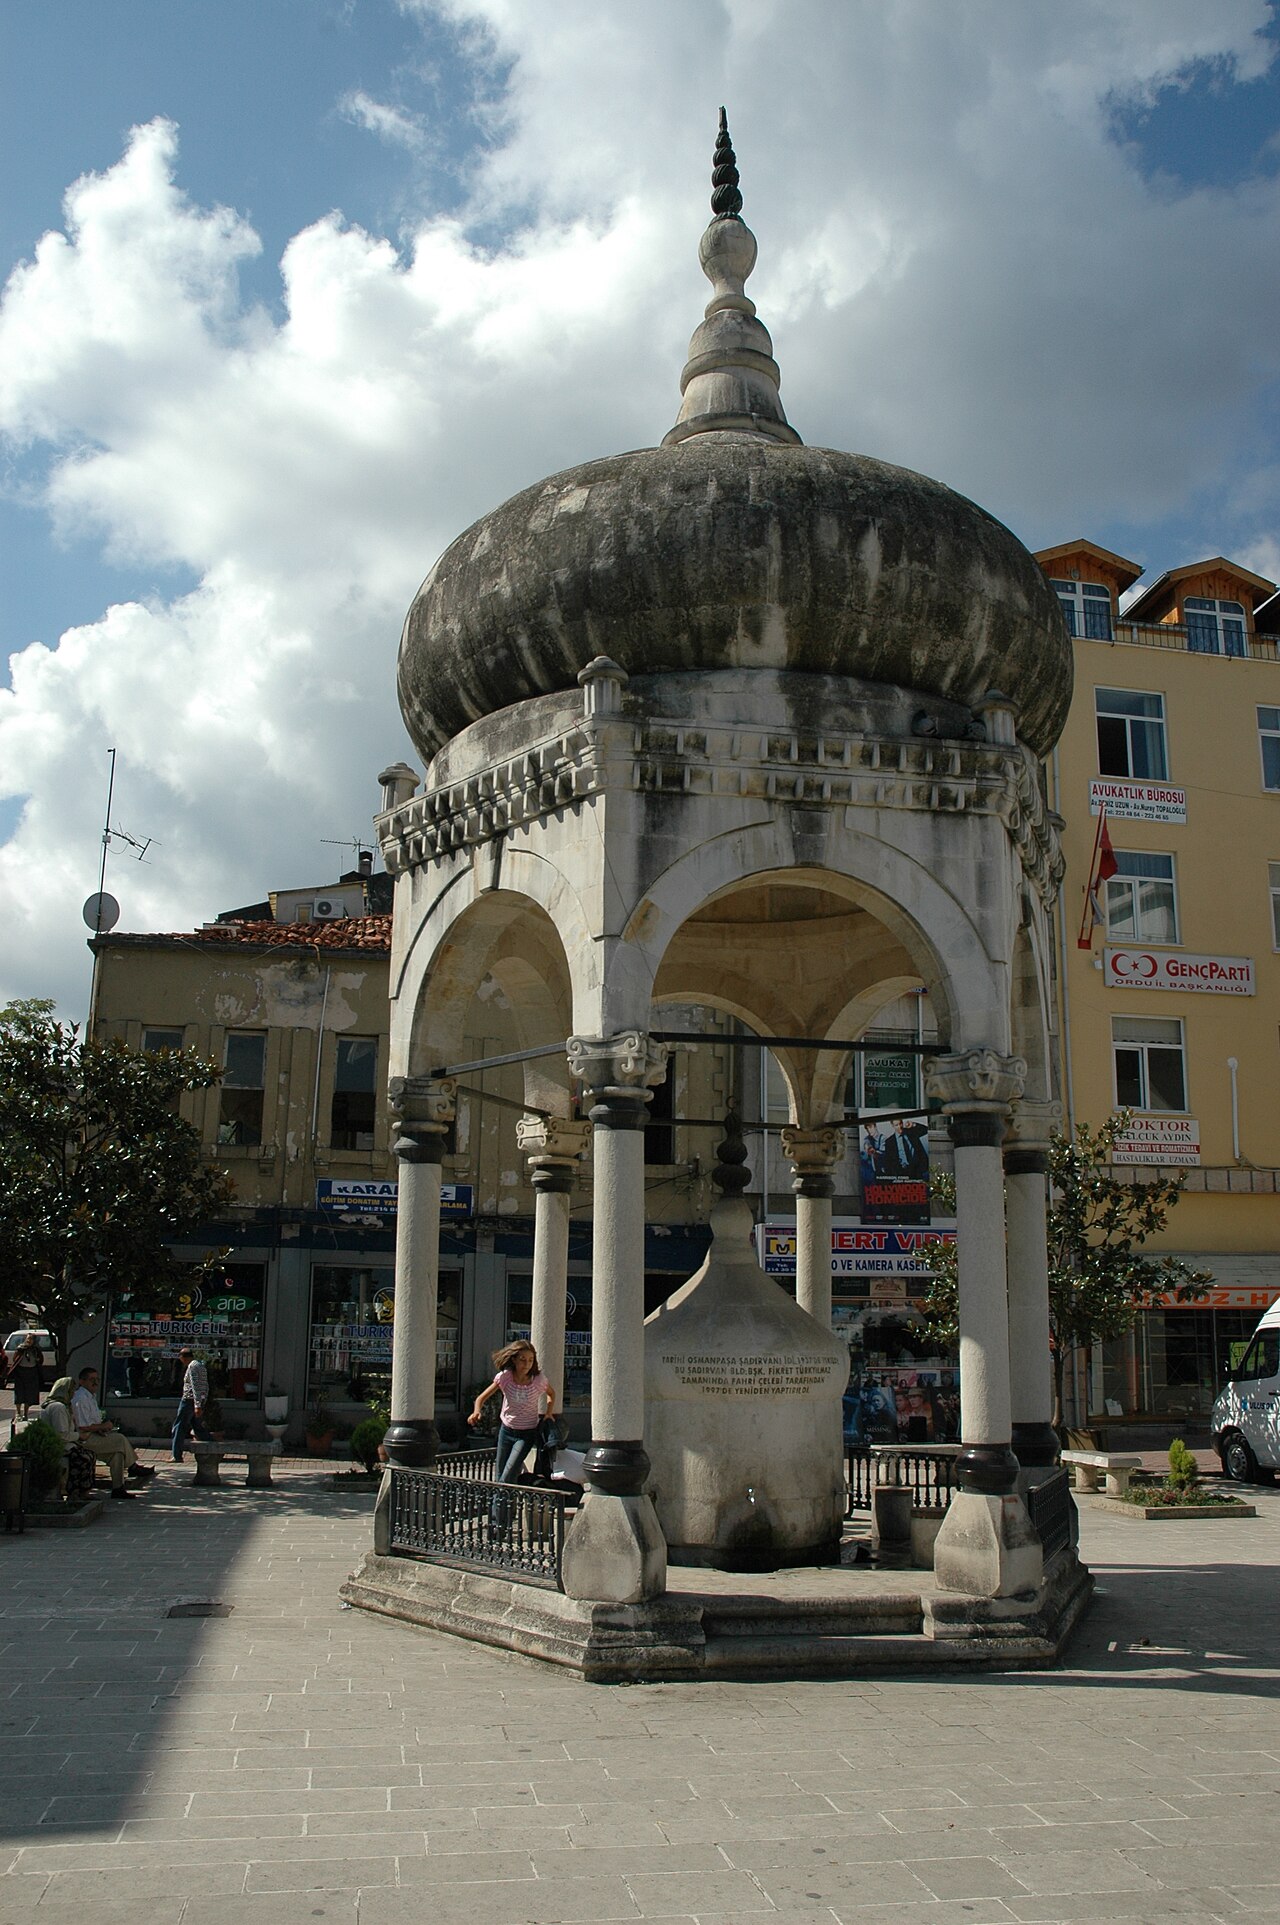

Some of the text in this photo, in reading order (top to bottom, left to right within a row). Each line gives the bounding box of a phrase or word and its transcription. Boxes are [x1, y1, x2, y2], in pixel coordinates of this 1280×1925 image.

[1092, 784, 1184, 804] AVUKATLIK BÜROSU
[1156, 805, 1186, 815] TOPALOĞLU
[1115, 978, 1247, 993] ORDU İL BAŞKANLIĞI
[867, 1058, 909, 1068] AVUKAT
[1160, 1133, 1191, 1141] AYDIN
[1152, 1144, 1160, 1152] VE
[1116, 1154, 1197, 1164] HASTALIKLAR UZMANI
[864, 1183, 926, 1195] HOLLYWOOD
[320, 1195, 346, 1204] EĞİTİM
[347, 1197, 380, 1205] DONATIM
[865, 1193, 927, 1205] HOMICIDE
[841, 1260, 852, 1271] VE
[855, 1260, 893, 1271] KAMERA
[217, 1298, 246, 1311] aria
[150, 1321, 227, 1335] TURKCELL
[662, 1354, 685, 1364] TARİHİ
[687, 1356, 736, 1366] OSMANPAŞA
[738, 1356, 782, 1366] ŞADIRVANI
[687, 1366, 726, 1375] ŞADIRVAN
[768, 1366, 793, 1375] FİKRET
[796, 1365, 831, 1375] TÜRKYILMAZ
[681, 1376, 729, 1385] ZAMANINDA
[759, 1376, 783, 1386] ÇELEBİ
[785, 1376, 825, 1385] TARAFINDAN
[735, 1385, 769, 1395] YENİDEN
